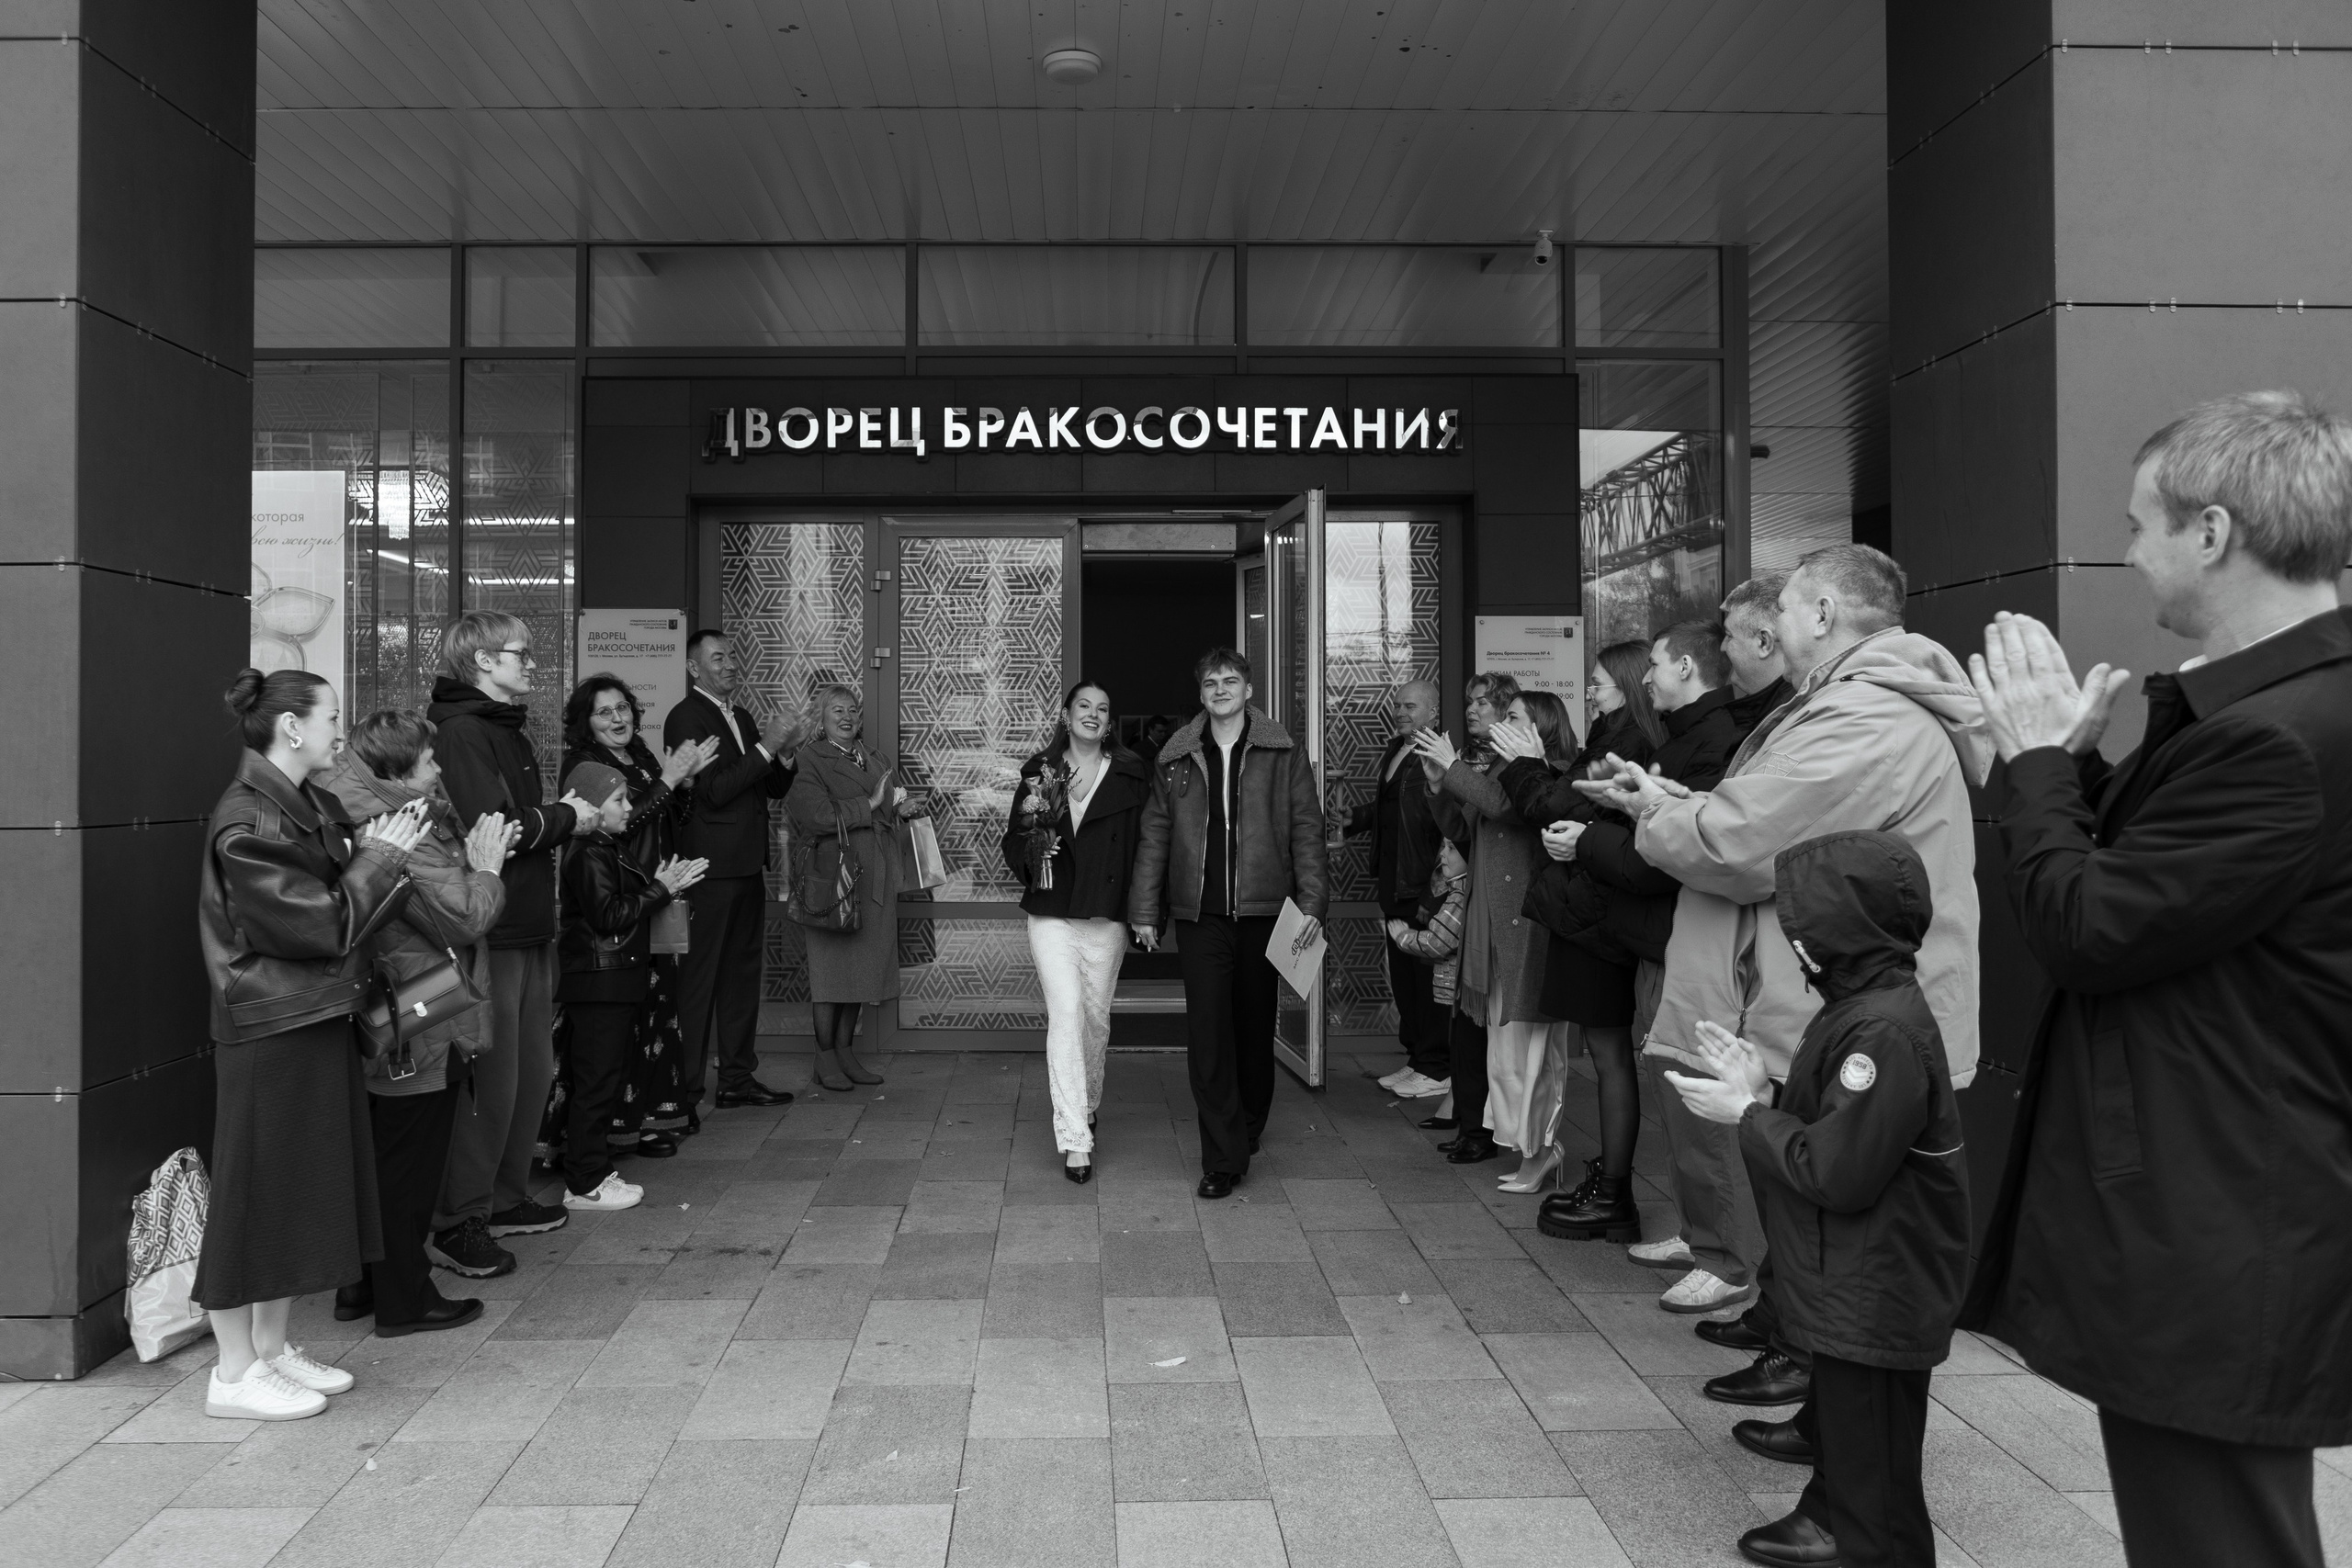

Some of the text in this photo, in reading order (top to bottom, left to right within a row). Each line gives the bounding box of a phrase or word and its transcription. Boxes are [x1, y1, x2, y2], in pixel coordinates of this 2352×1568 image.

[702, 406, 1464, 457] ДВОРЕЦ БРАКОСОЧЕТАНИЯ
[588, 631, 627, 641] ДВОРЕЦ
[588, 643, 675, 652] БРАКОСОЧЕТАНИЯ
[1852, 1059, 1867, 1069] 1958
